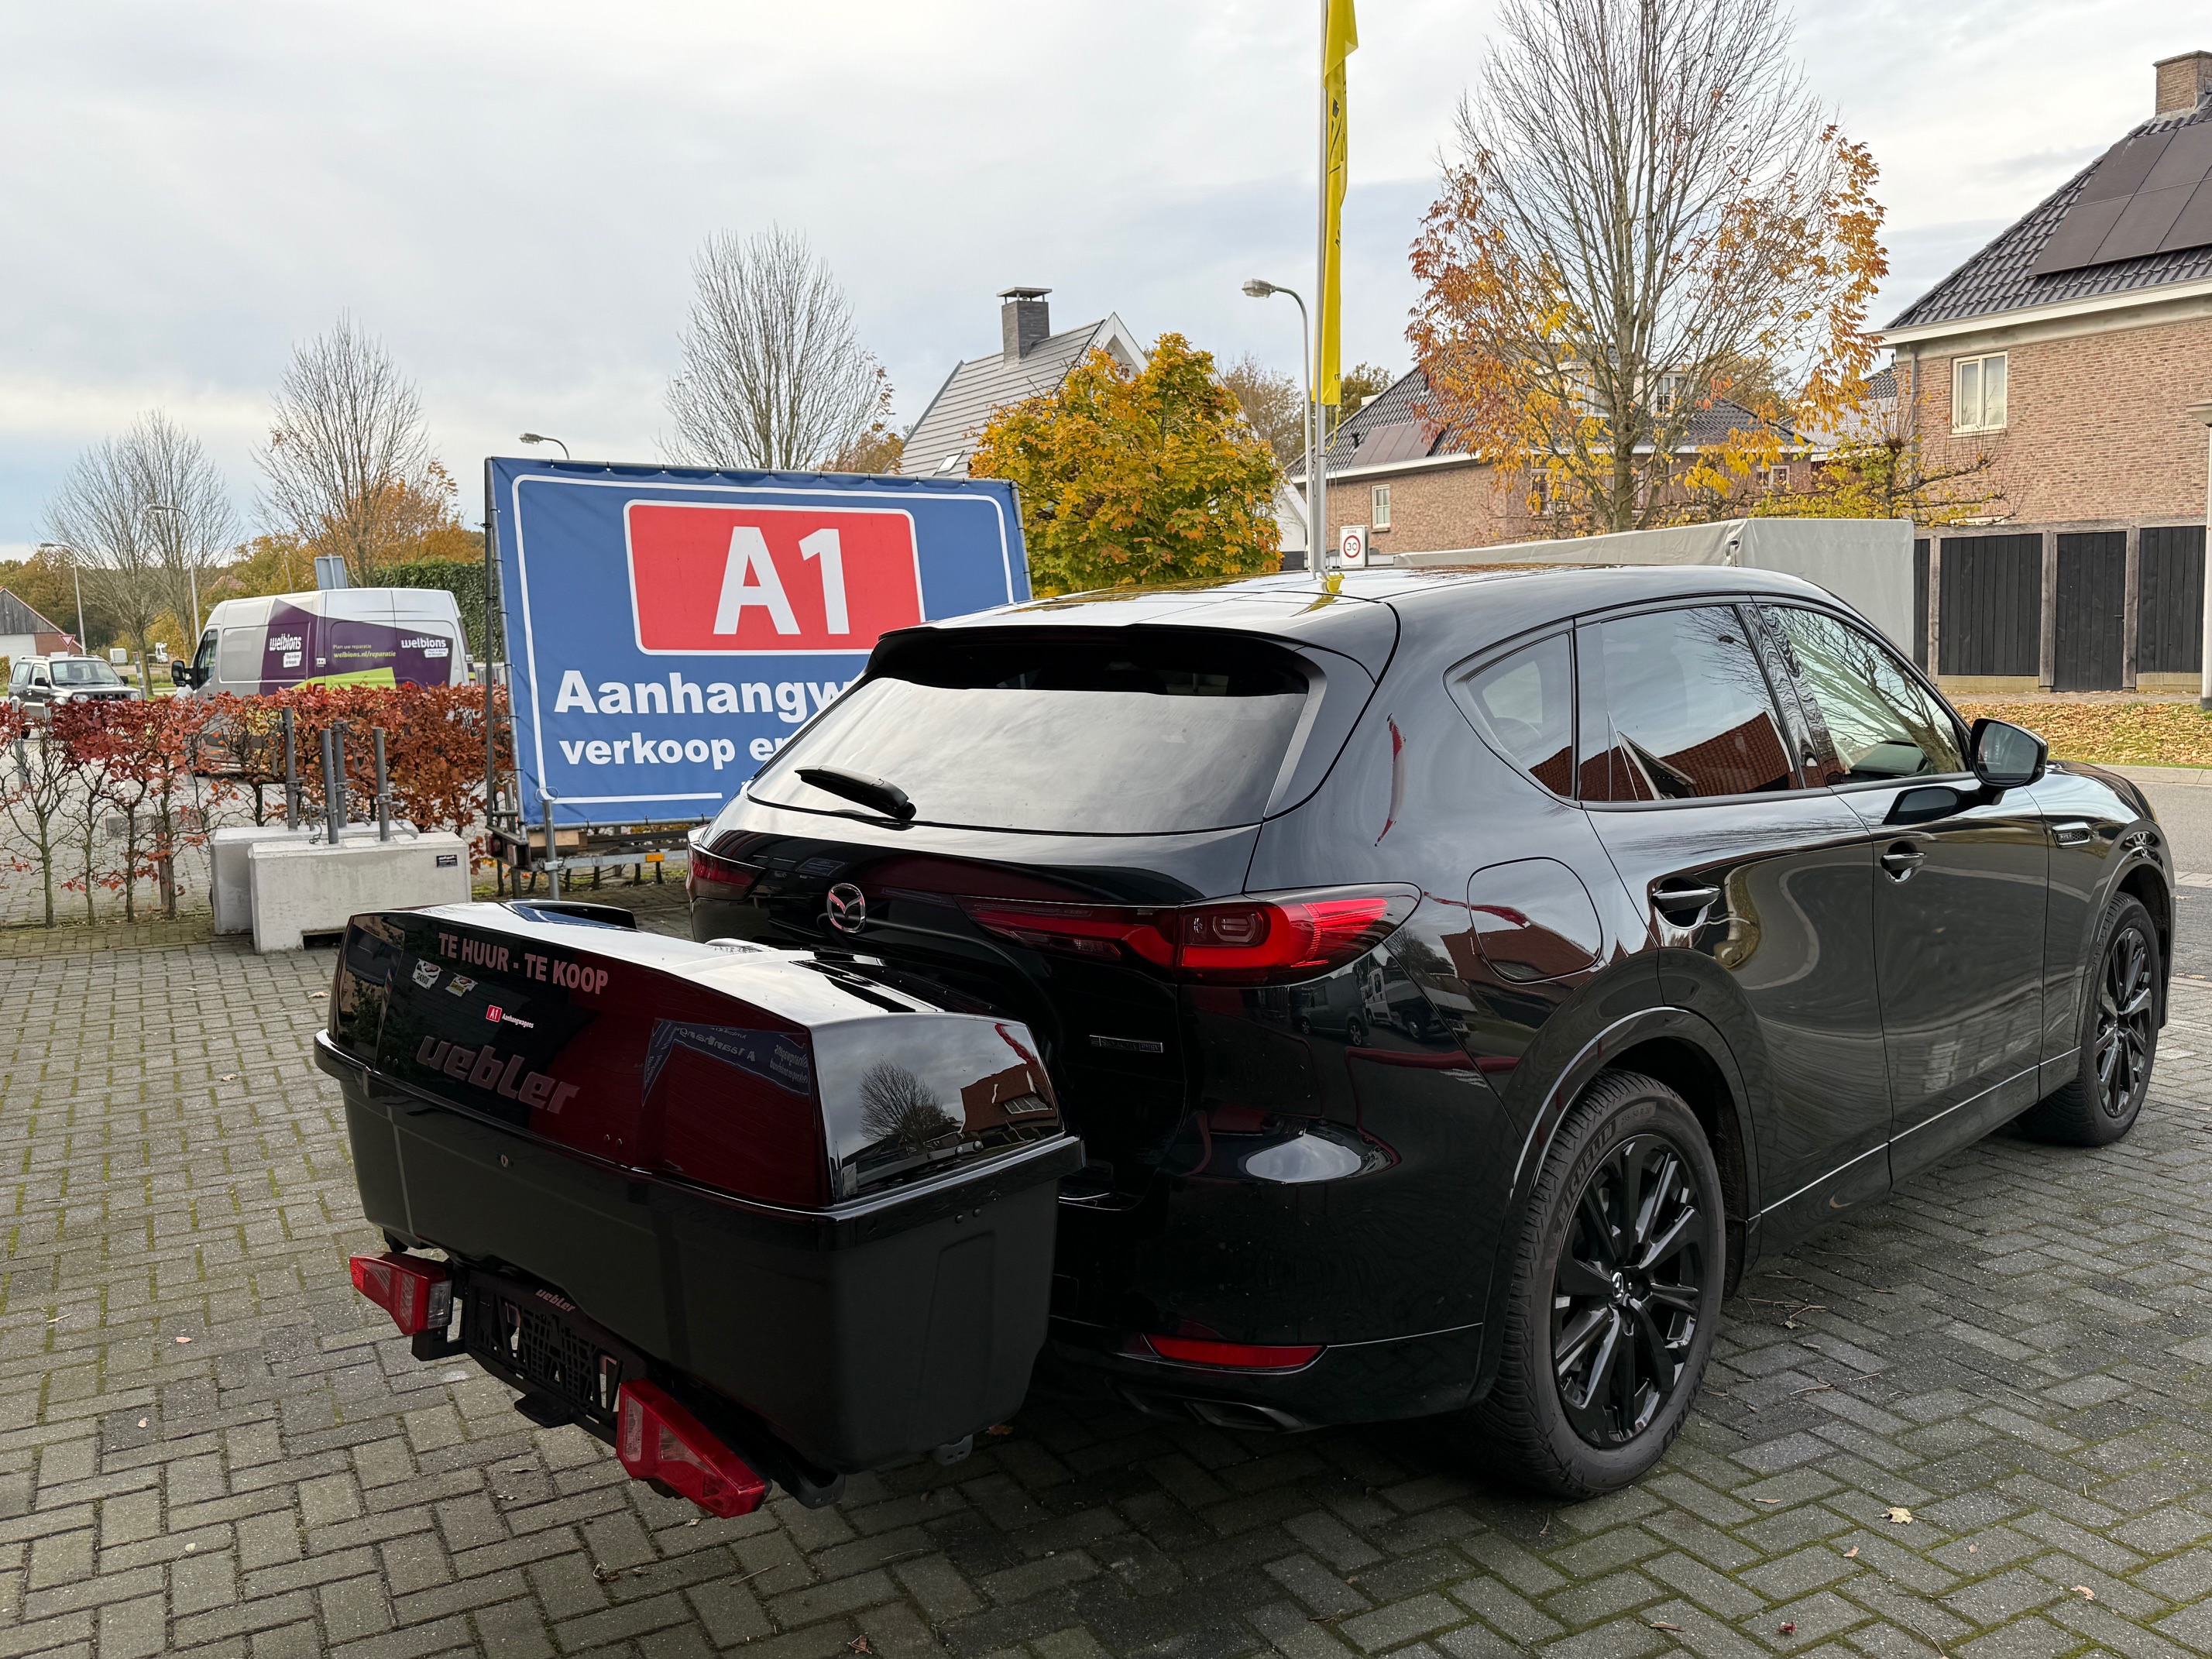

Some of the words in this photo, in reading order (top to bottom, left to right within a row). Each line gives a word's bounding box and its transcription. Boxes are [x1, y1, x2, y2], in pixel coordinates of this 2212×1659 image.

[1347, 542, 1358, 551] 30
[713, 525, 850, 635] A1
[269, 633, 302, 651] welbions
[400, 637, 447, 649] welbions
[333, 650, 397, 658] welbions.nl/reparatie
[559, 732, 735, 770] verkoop
[438, 933, 459, 958] TE
[462, 938, 509, 972] HUUR
[524, 953, 547, 981] TE
[553, 960, 608, 994] KOOP
[489, 1008, 499, 1020] A1
[416, 1035, 580, 1115] uebler
[1558, 1120, 1615, 1225] MICHELIN
[535, 1289, 576, 1312] uebler
